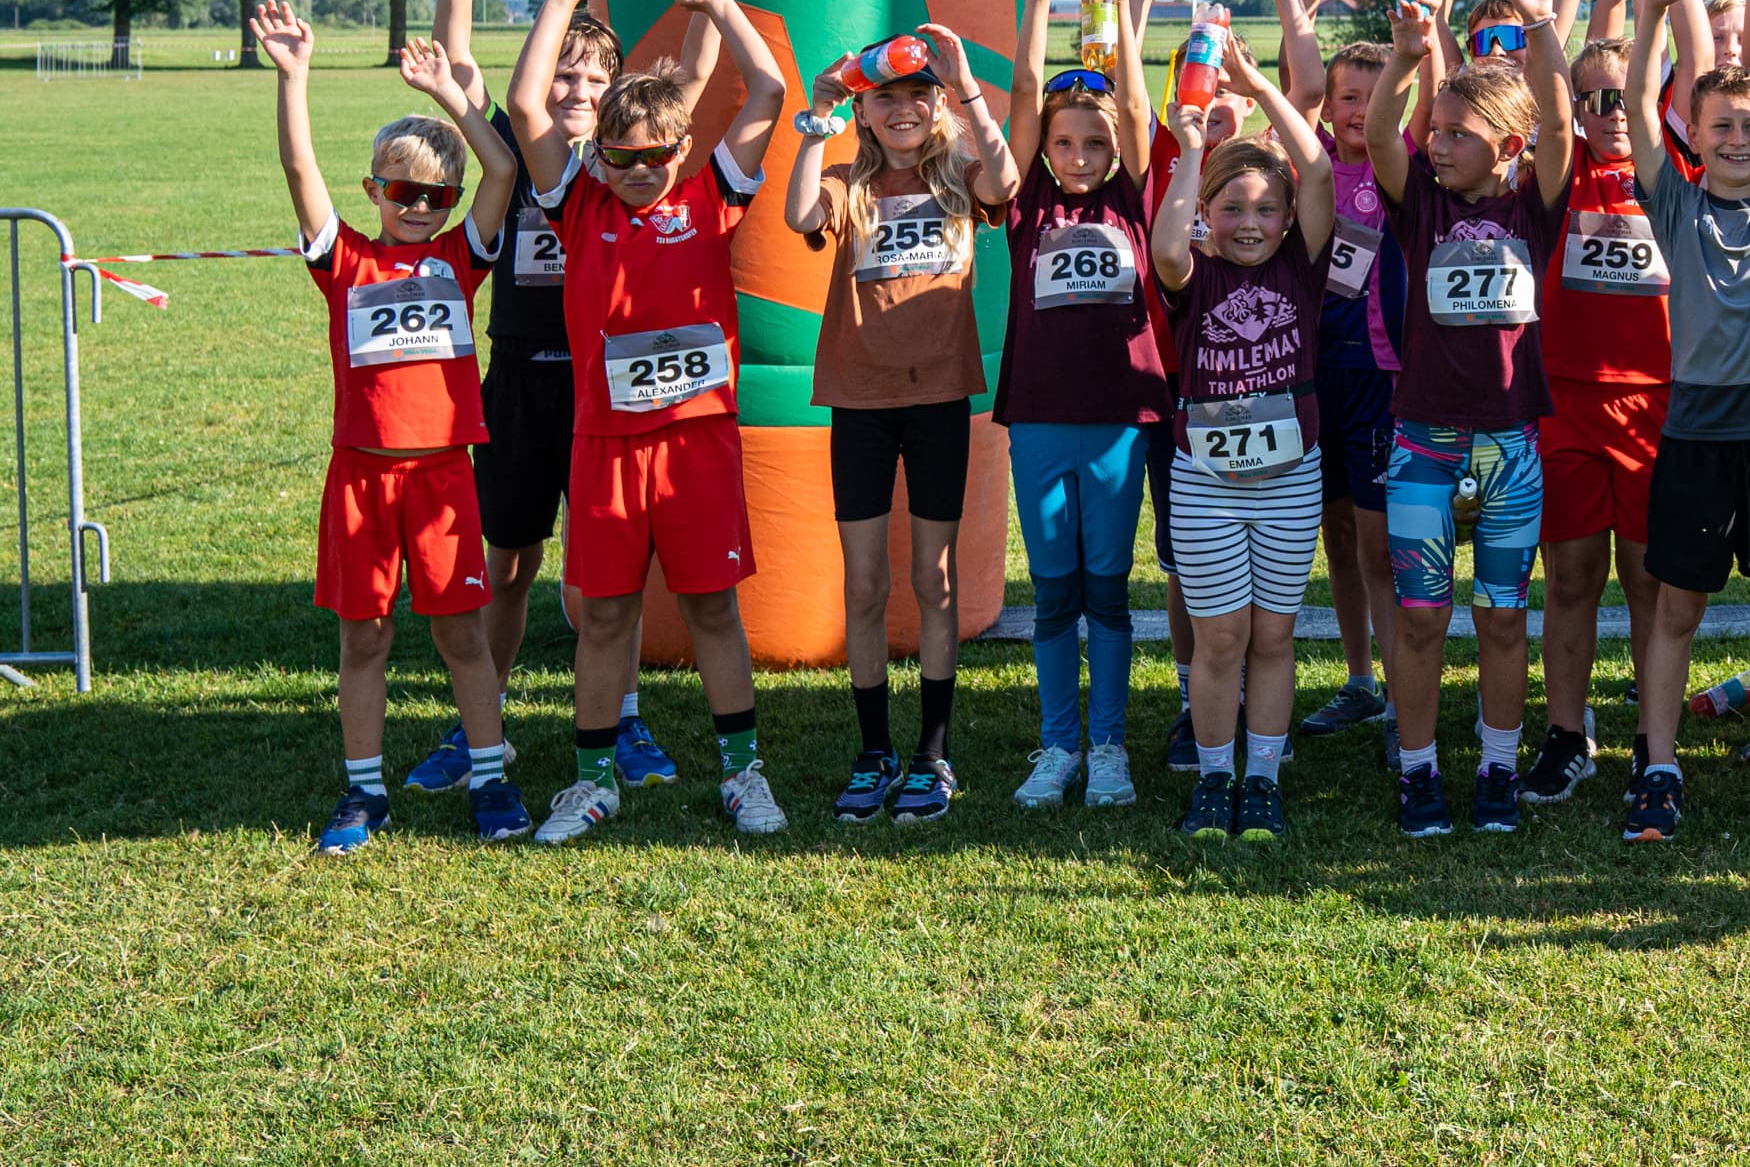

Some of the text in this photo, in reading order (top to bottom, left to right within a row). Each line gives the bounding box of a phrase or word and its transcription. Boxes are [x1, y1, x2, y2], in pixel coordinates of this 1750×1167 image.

[1050, 250, 1120, 281] 268
[1580, 239, 1653, 271] 259
[1066, 280, 1106, 290] MIRIAM
[1446, 268, 1518, 298] 277
[1592, 270, 1639, 281] MAGNUS
[1452, 299, 1517, 310] PHILOMENA
[371, 303, 453, 337] 262
[389, 335, 439, 347] JOHANN
[629, 351, 711, 387] 258
[1209, 363, 1296, 395] TRIATHLON
[1206, 424, 1277, 458] 271
[1229, 457, 1263, 469] EMMA
